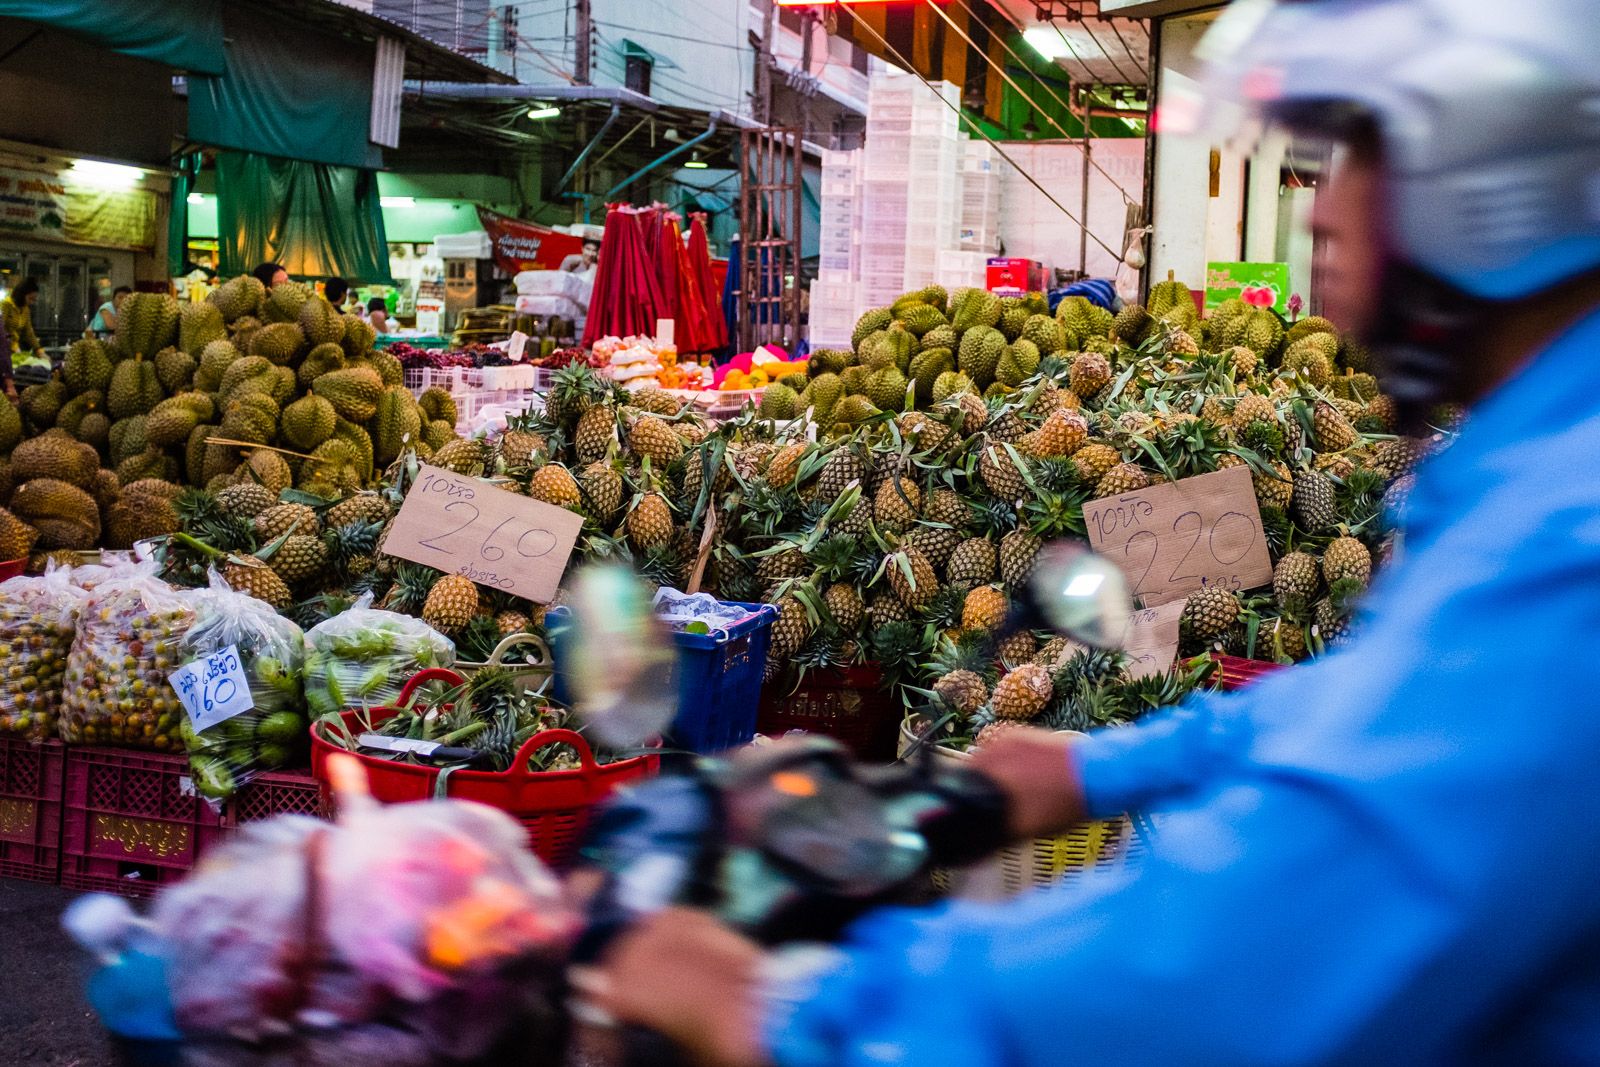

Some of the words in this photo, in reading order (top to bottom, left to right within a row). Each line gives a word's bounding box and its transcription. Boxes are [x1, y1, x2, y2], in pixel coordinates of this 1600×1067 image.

[418, 501, 557, 561] 260
[1125, 510, 1256, 597] 220
[190, 678, 236, 719] 260
